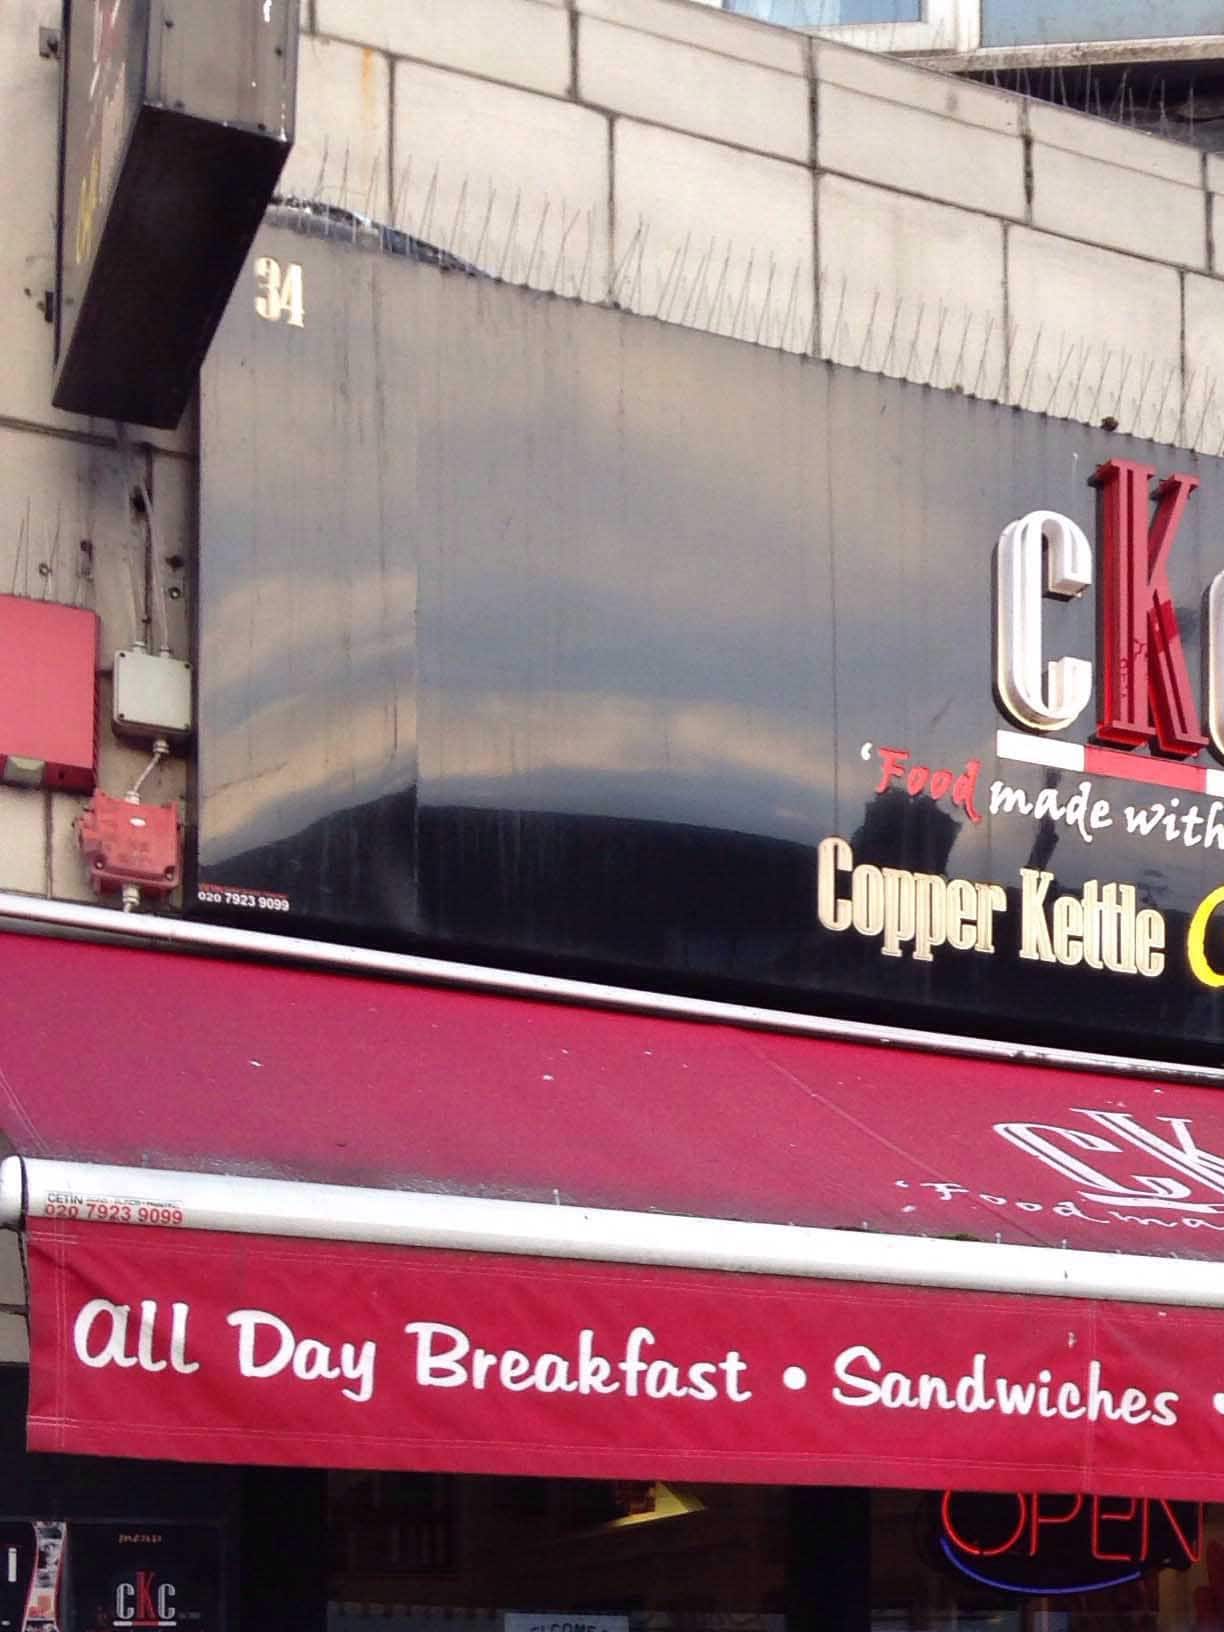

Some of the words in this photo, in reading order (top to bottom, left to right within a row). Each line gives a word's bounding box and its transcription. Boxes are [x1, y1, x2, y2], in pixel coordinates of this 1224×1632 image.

[255, 256, 304, 328] 34
[989, 778, 1112, 843] made
[197, 891, 222, 904] 020
[224, 892, 256, 907] 7923
[257, 896, 290, 912] 9099
[816, 835, 1007, 962] Copper
[1018, 866, 1166, 978] Kettle
[45, 1203, 79, 1218] 020
[86, 1203, 132, 1220] 7923
[138, 1207, 184, 1224] 9099
[47, 1192, 83, 1205] CETIN
[227, 1310, 376, 1402] Day
[405, 1322, 752, 1402] Breakfast
[832, 1339, 1179, 1426] Sandwiches
[941, 1489, 1204, 1563] OPEN
[116, 1569, 177, 1622] CKC
